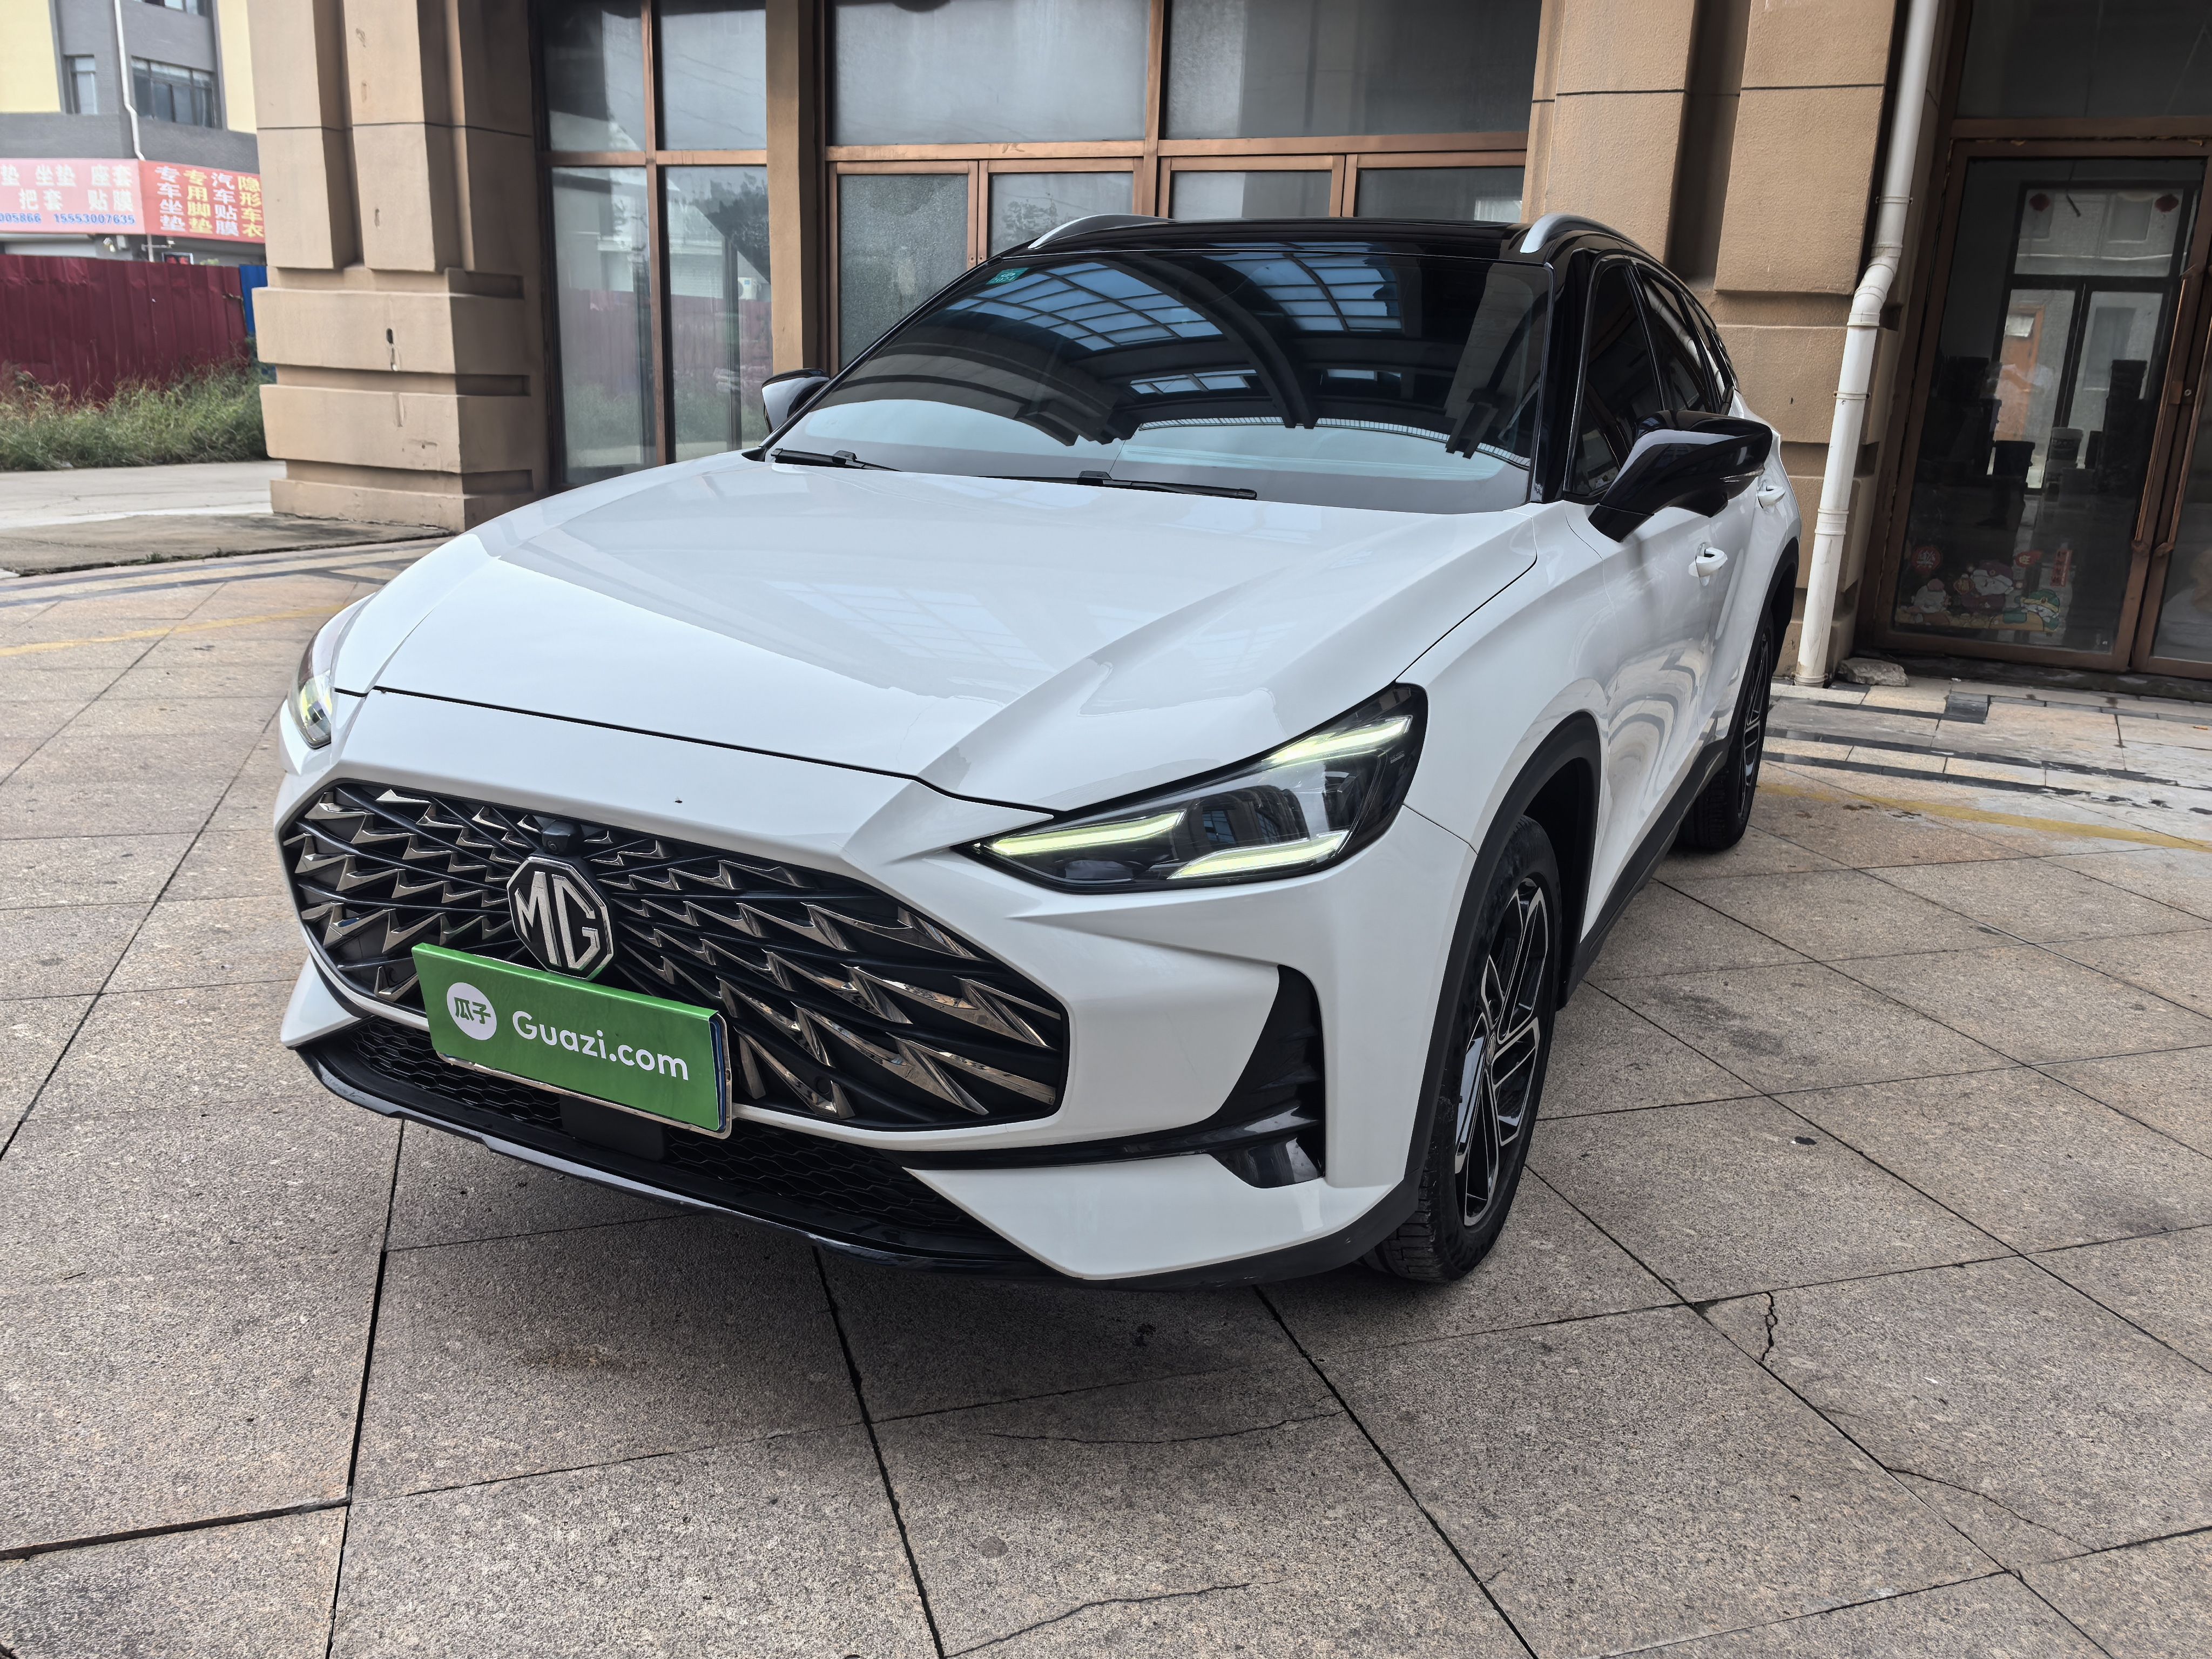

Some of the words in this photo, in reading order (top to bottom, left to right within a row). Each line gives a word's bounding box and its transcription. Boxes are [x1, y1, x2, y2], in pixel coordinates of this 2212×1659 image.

[1, 164, 20, 186] 垫
[36, 164, 76, 187] 坐垫
[91, 165, 133, 187] 座套
[19, 189, 63, 211] 把套
[87, 189, 133, 212] 贴膜
[156, 166, 185, 232] 专车坐垫
[185, 170, 212, 233] 专用脚垫
[212, 172, 239, 236] 汽车贴膜
[239, 176, 264, 237] 隐形车衣
[515, 871, 601, 970] MG
[454, 996, 491, 1025] 瓜子
[512, 1010, 689, 1081] Guazi.com
